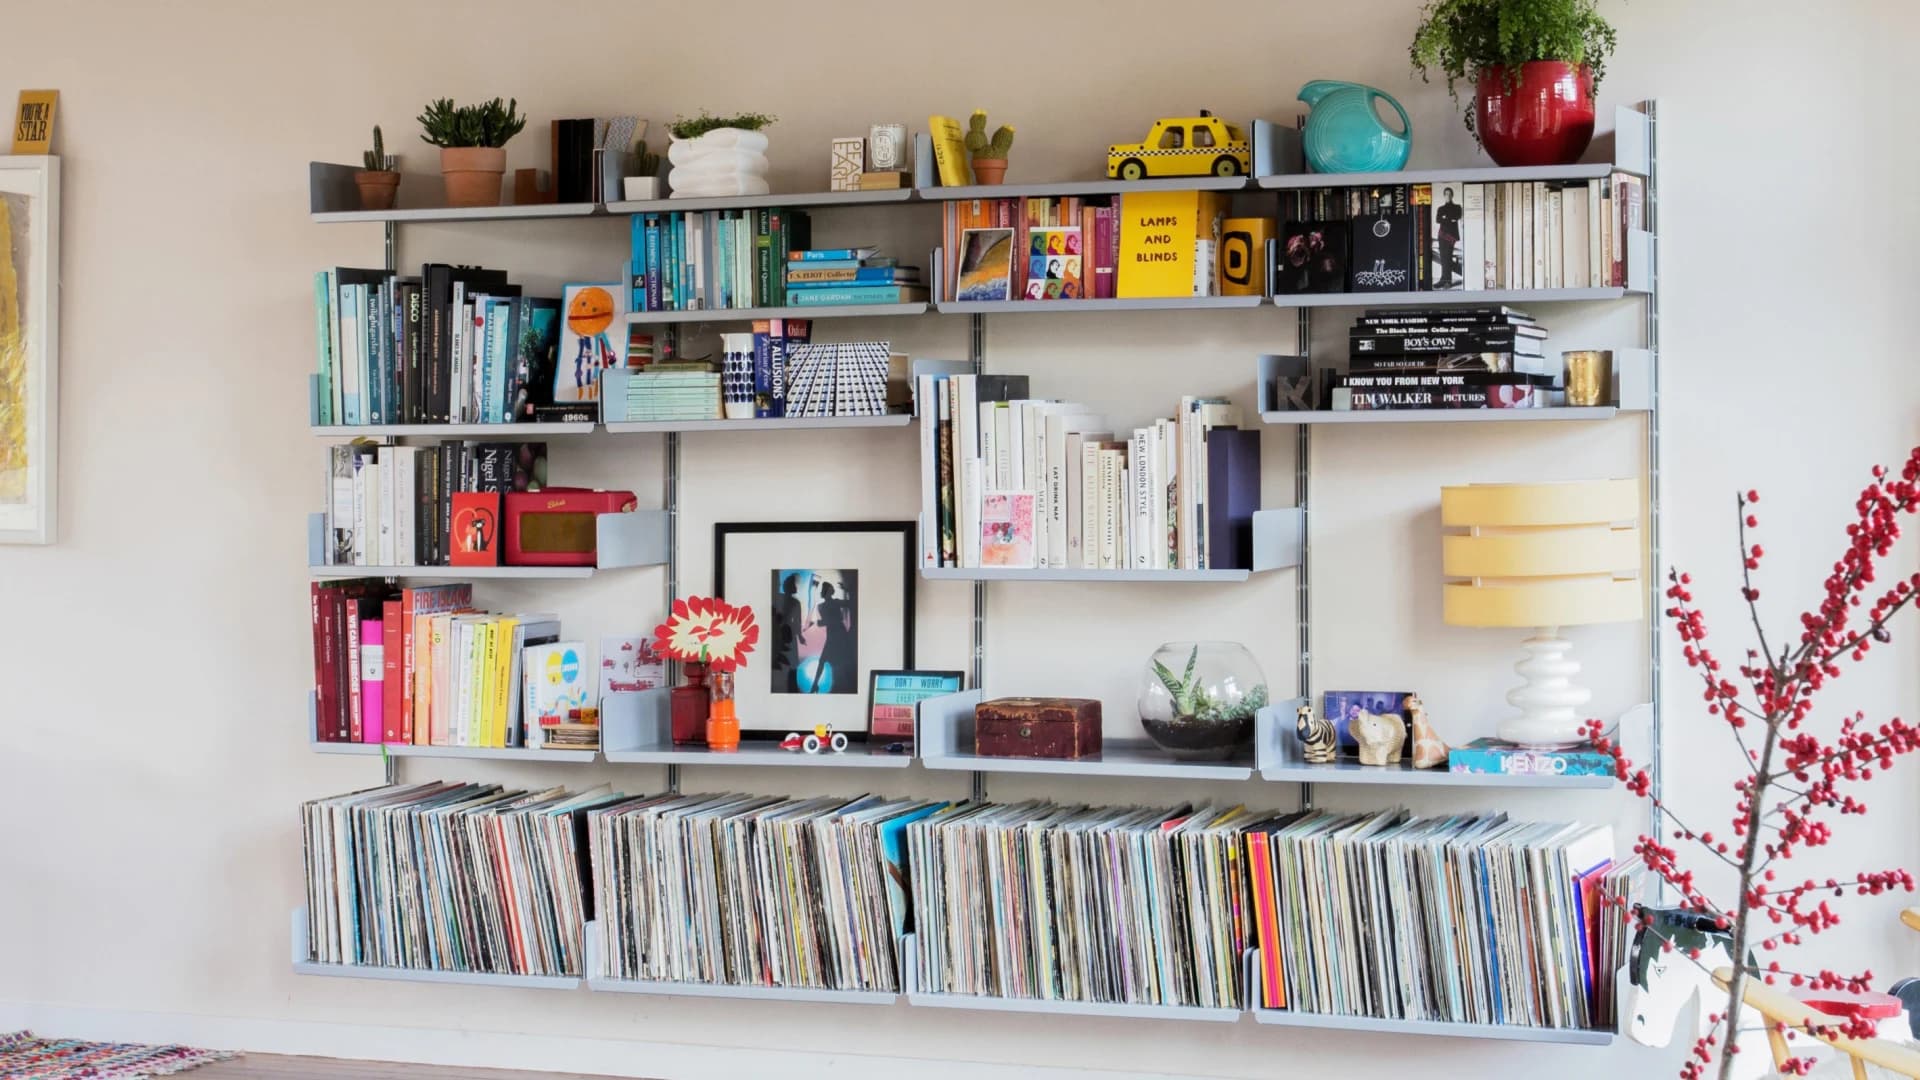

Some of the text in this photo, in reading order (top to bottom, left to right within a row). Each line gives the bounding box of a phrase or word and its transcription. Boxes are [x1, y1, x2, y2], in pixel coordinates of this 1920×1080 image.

[17, 121, 47, 141] STAR
[1141, 217, 1177, 227] LAMPS
[1144, 235, 1171, 245] AND
[1136, 252, 1178, 263] BLINDS
[650, 267, 658, 308] DICTIONARY
[411, 293, 420, 322] DISCO
[486, 312, 494, 363] MARRAKESH
[1404, 336, 1456, 347] BOY'S OWN
[772, 346, 784, 399] ALLUSIONS
[1349, 377, 1374, 386] KNOW
[1376, 377, 1392, 385] YOU
[1394, 377, 1418, 385] FROM
[1421, 377, 1439, 385] NEW
[1441, 376, 1464, 385] YORK
[484, 381, 492, 412] DESIGN
[1352, 392, 1486, 405] TIM WALKER PICTURES
[562, 413, 589, 421] 1960s
[1138, 434, 1147, 453] NEW
[481, 449, 497, 481] Nigel
[502, 449, 513, 482] Nigel
[1139, 455, 1147, 488] LONDON
[415, 586, 472, 609] FIRE ISLAND
[349, 630, 358, 649] CAN
[894, 678, 944, 689] DON'T WORRY
[1500, 756, 1568, 774] KENZO
